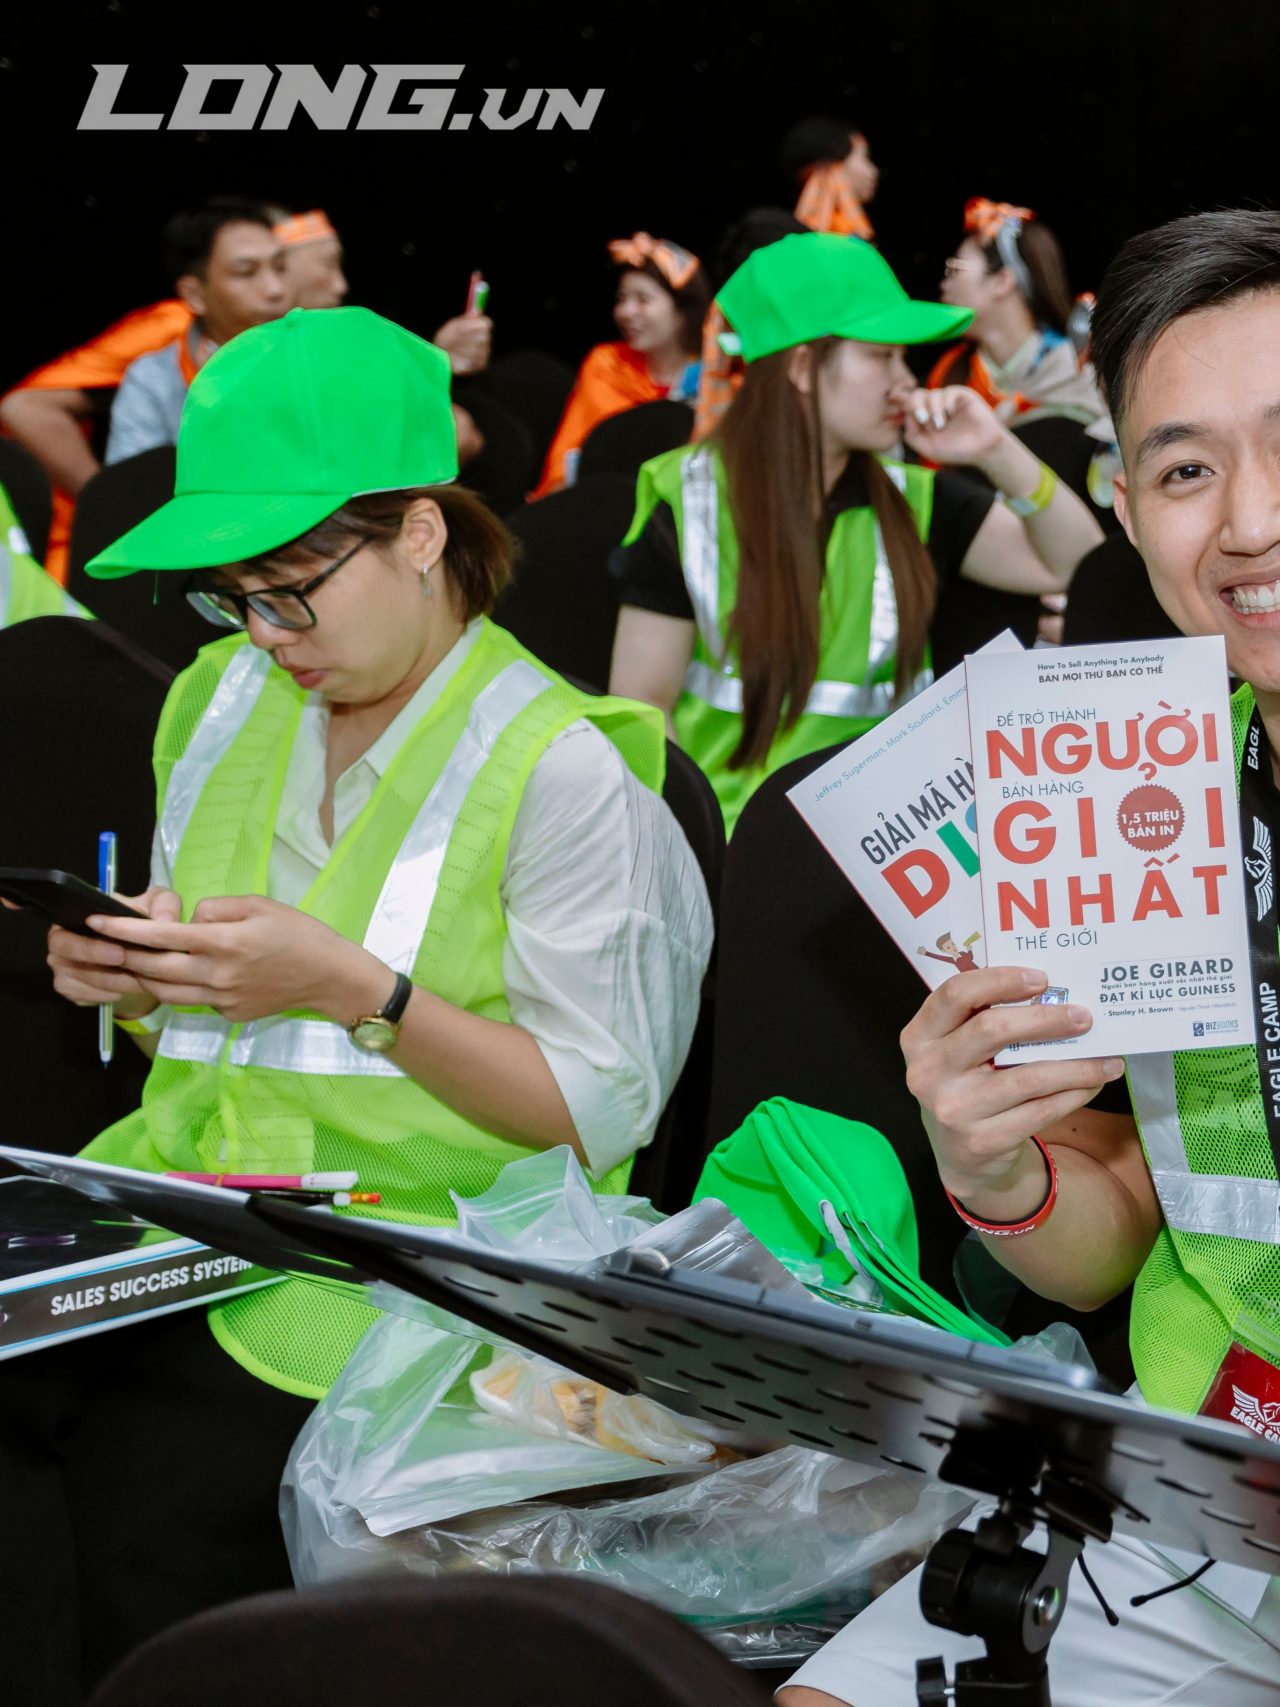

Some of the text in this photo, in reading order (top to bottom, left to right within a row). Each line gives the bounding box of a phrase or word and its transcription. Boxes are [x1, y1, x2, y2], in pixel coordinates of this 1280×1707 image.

[1068, 660, 1082, 668] Sell
[1084, 658, 1118, 667] Anything
[1130, 654, 1164, 664] Anybody
[1062, 672, 1082, 682] MỌI
[1106, 669, 1126, 679] BẠN
[1018, 708, 1044, 726] TRỞ
[1050, 706, 1096, 723] THÀNH
[986, 700, 1218, 779] NGƯỜI
[814, 778, 844, 802] Jeffrey
[842, 744, 887, 780] Sugerman,
[886, 730, 908, 748] Mark
[908, 704, 944, 732] Scullard,
[1002, 780, 1084, 798] BÁN HÀNG
[860, 812, 916, 864] GIẢI
[907, 779, 956, 831] MÃ
[1121, 808, 1180, 826] 1,5 TRIỆU
[1160, 824, 1174, 836] IN
[997, 853, 1227, 932] NHẤT
[1016, 928, 1098, 950] THẾ GIỚI
[1100, 958, 1234, 982] JOE GIRARD
[1100, 992, 1125, 1004] ĐẠT
[1149, 988, 1172, 1000] LỤC
[1178, 983, 1236, 996] GUINESS
[1108, 1008, 1136, 1017] Stanley
[1148, 1006, 1174, 1014] Brown
[51, 1286, 104, 1316] SALES
[109, 1265, 189, 1302] SUCCESS
[1230, 1406, 1265, 1434] EAGLE
